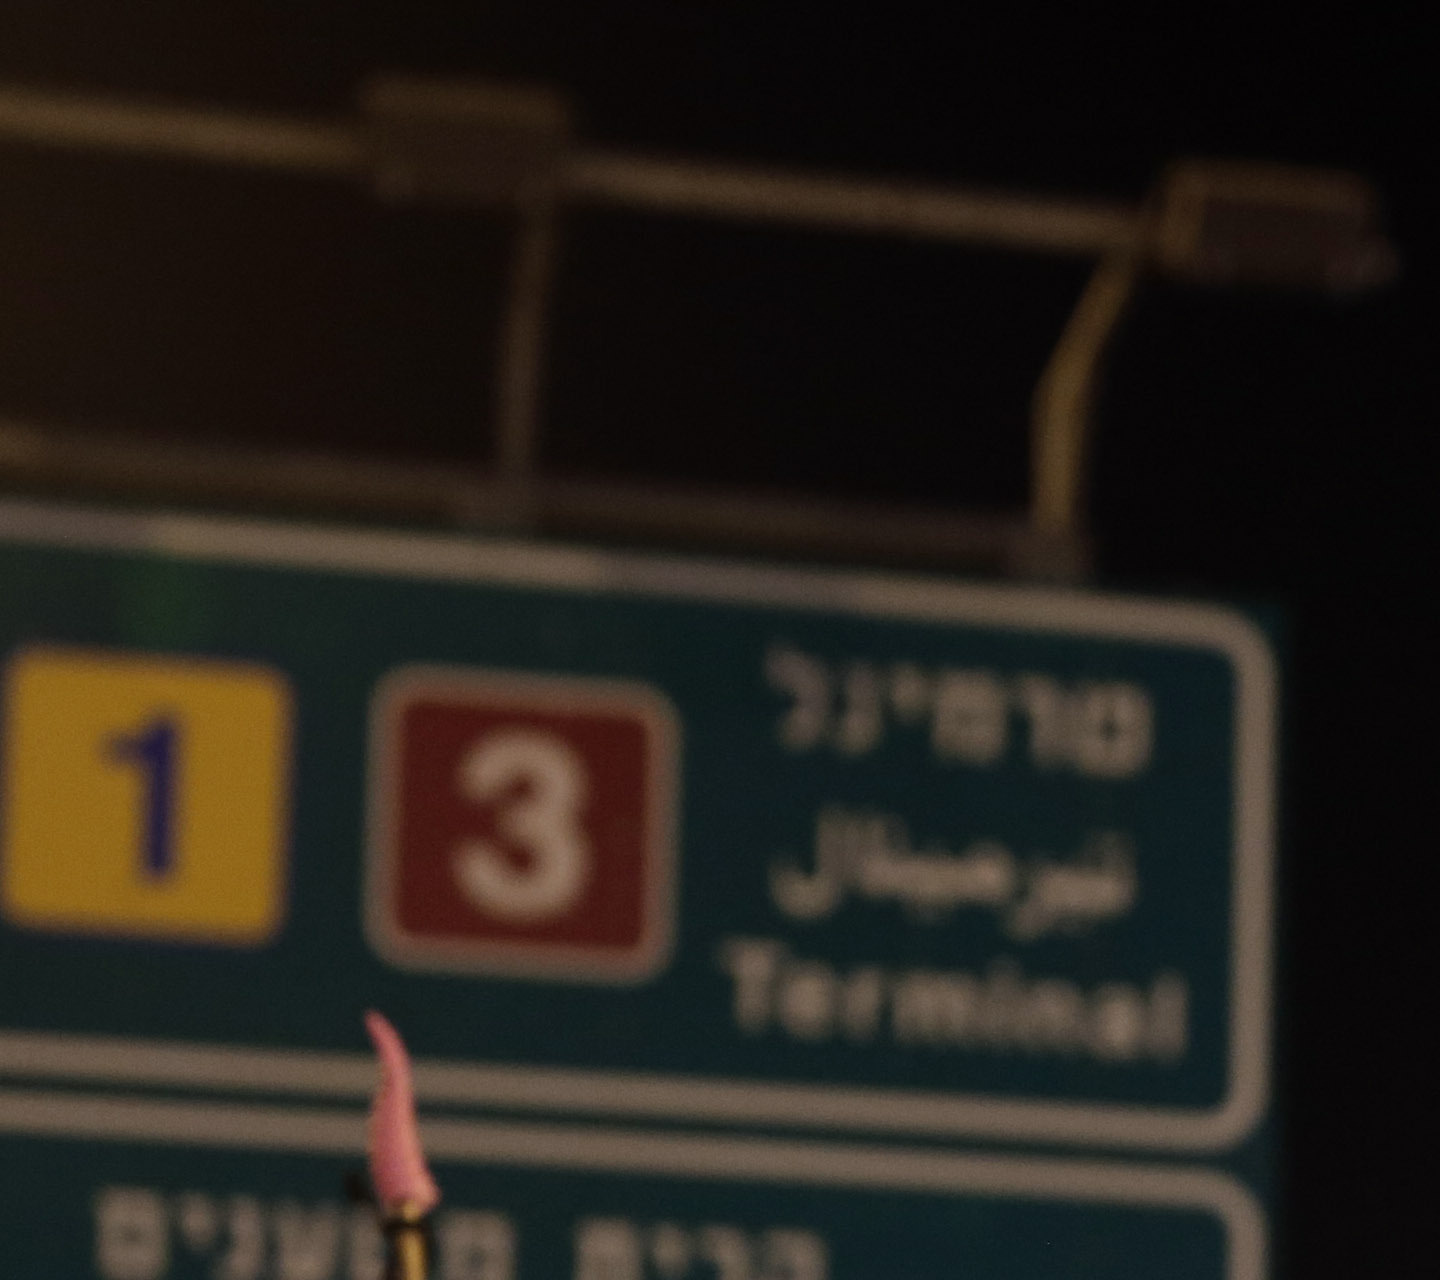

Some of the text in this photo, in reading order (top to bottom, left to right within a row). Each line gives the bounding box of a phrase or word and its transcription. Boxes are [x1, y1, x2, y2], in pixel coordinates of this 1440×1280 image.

[763, 645, 1155, 779] טרמינל
[101, 707, 181, 886] 1
[453, 730, 590, 920] 3
[718, 937, 1190, 1064] Terminal
